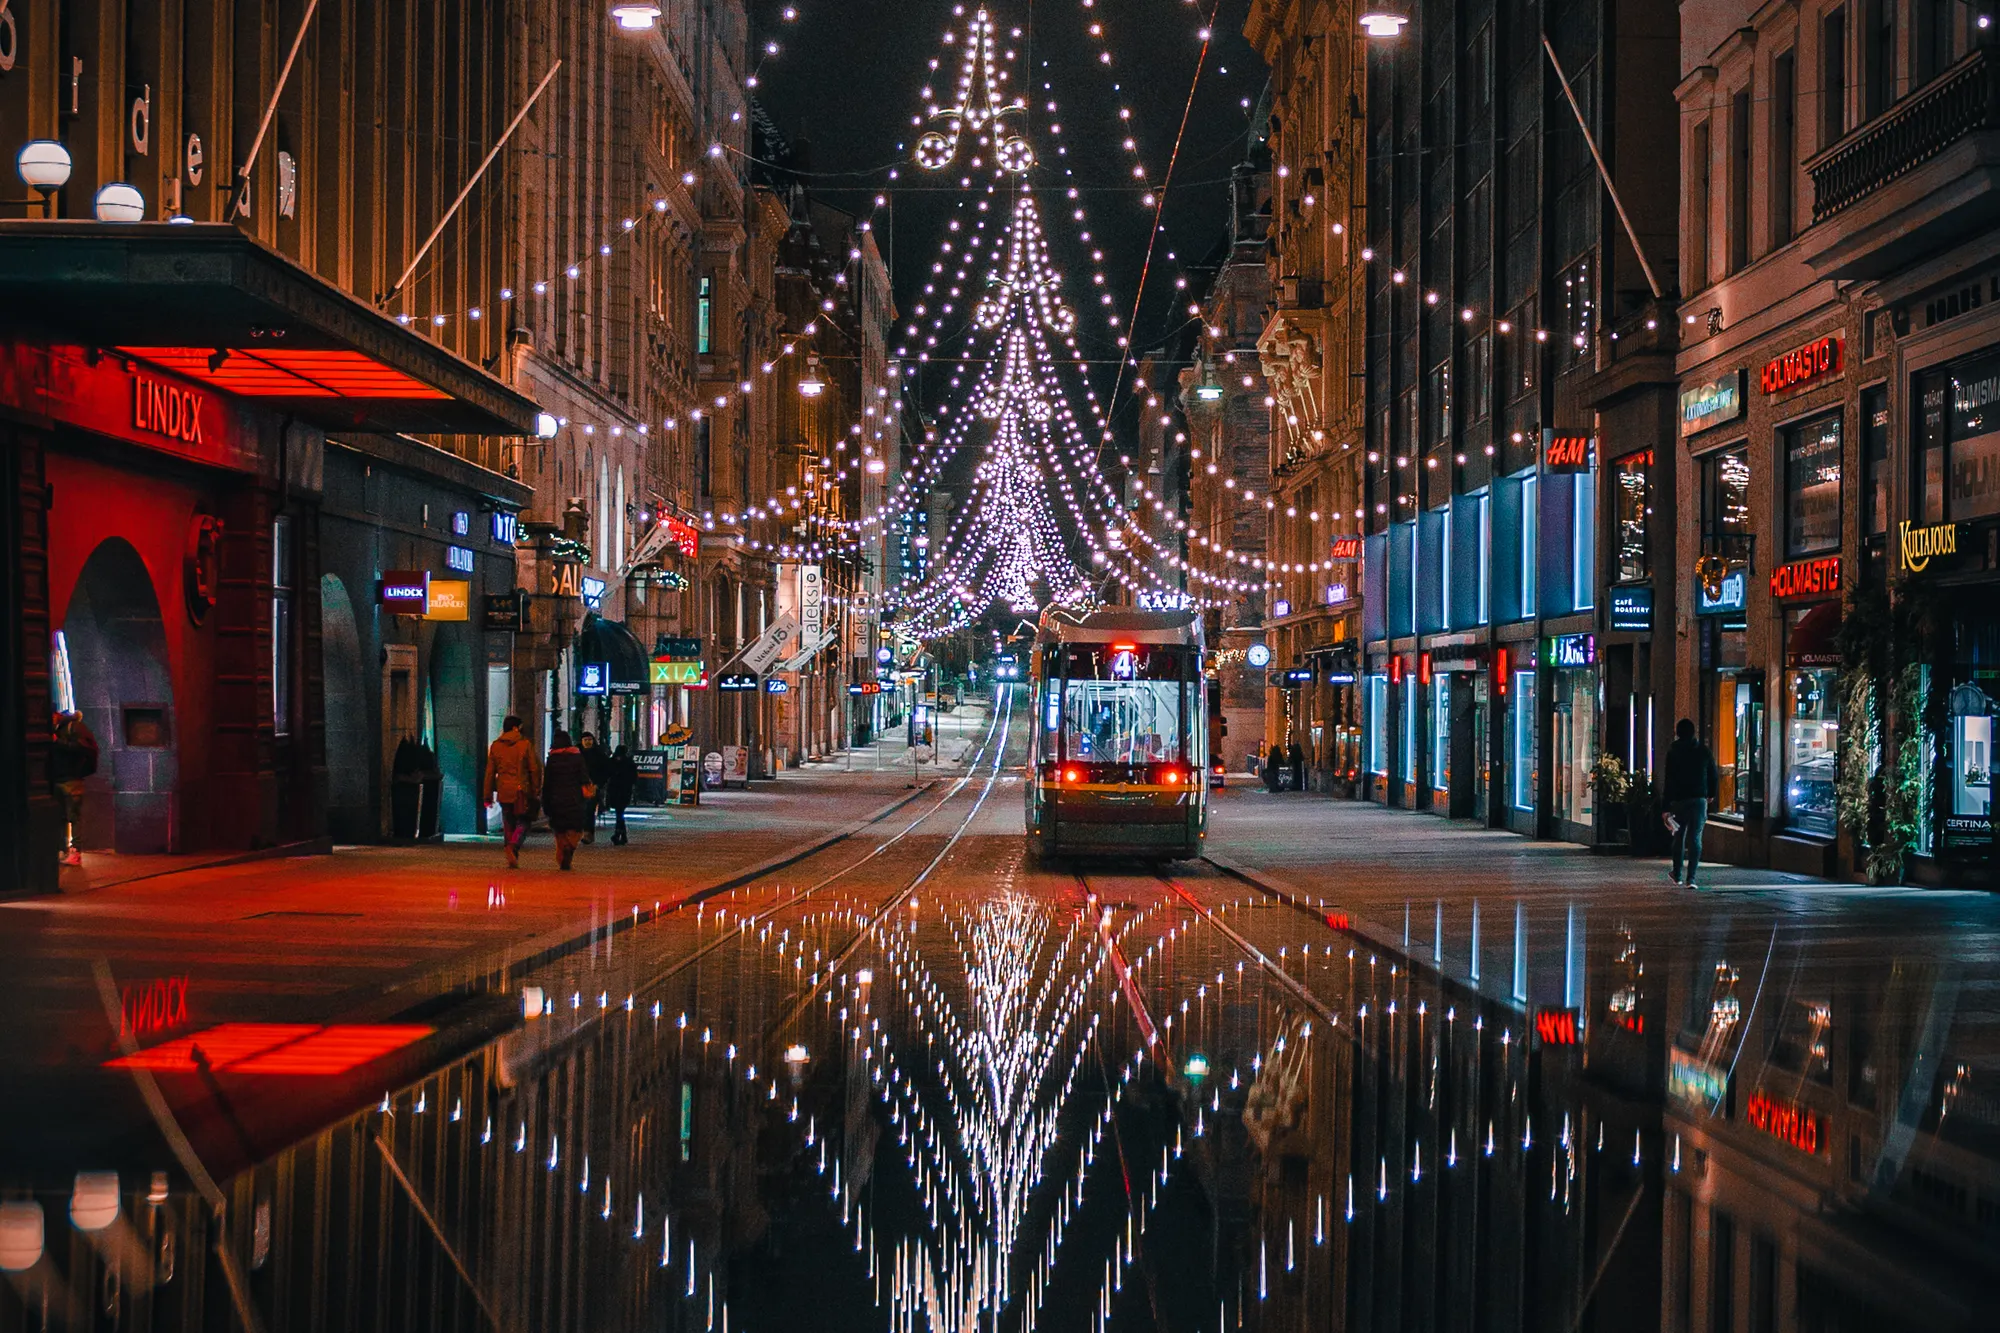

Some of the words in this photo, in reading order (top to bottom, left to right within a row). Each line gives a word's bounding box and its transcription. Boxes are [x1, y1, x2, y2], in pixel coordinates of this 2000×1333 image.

[1760, 337, 1830, 396] HOLMASTO
[135, 375, 203, 445] LINDEX
[1546, 437, 1587, 465] H&M
[1899, 519, 1956, 572] KULTAJOUSI
[1769, 557, 1839, 598] HOLMASTO
[387, 587, 424, 597] LINDEX
[1614, 597, 1633, 606] CAFÉ
[803, 585, 819, 634] aleksi
[1614, 605, 1650, 614] ROASTERY
[1114, 651, 1131, 677] 4
[633, 754, 663, 765] ELIXIA
[1946, 818, 1992, 829] CERTINA
